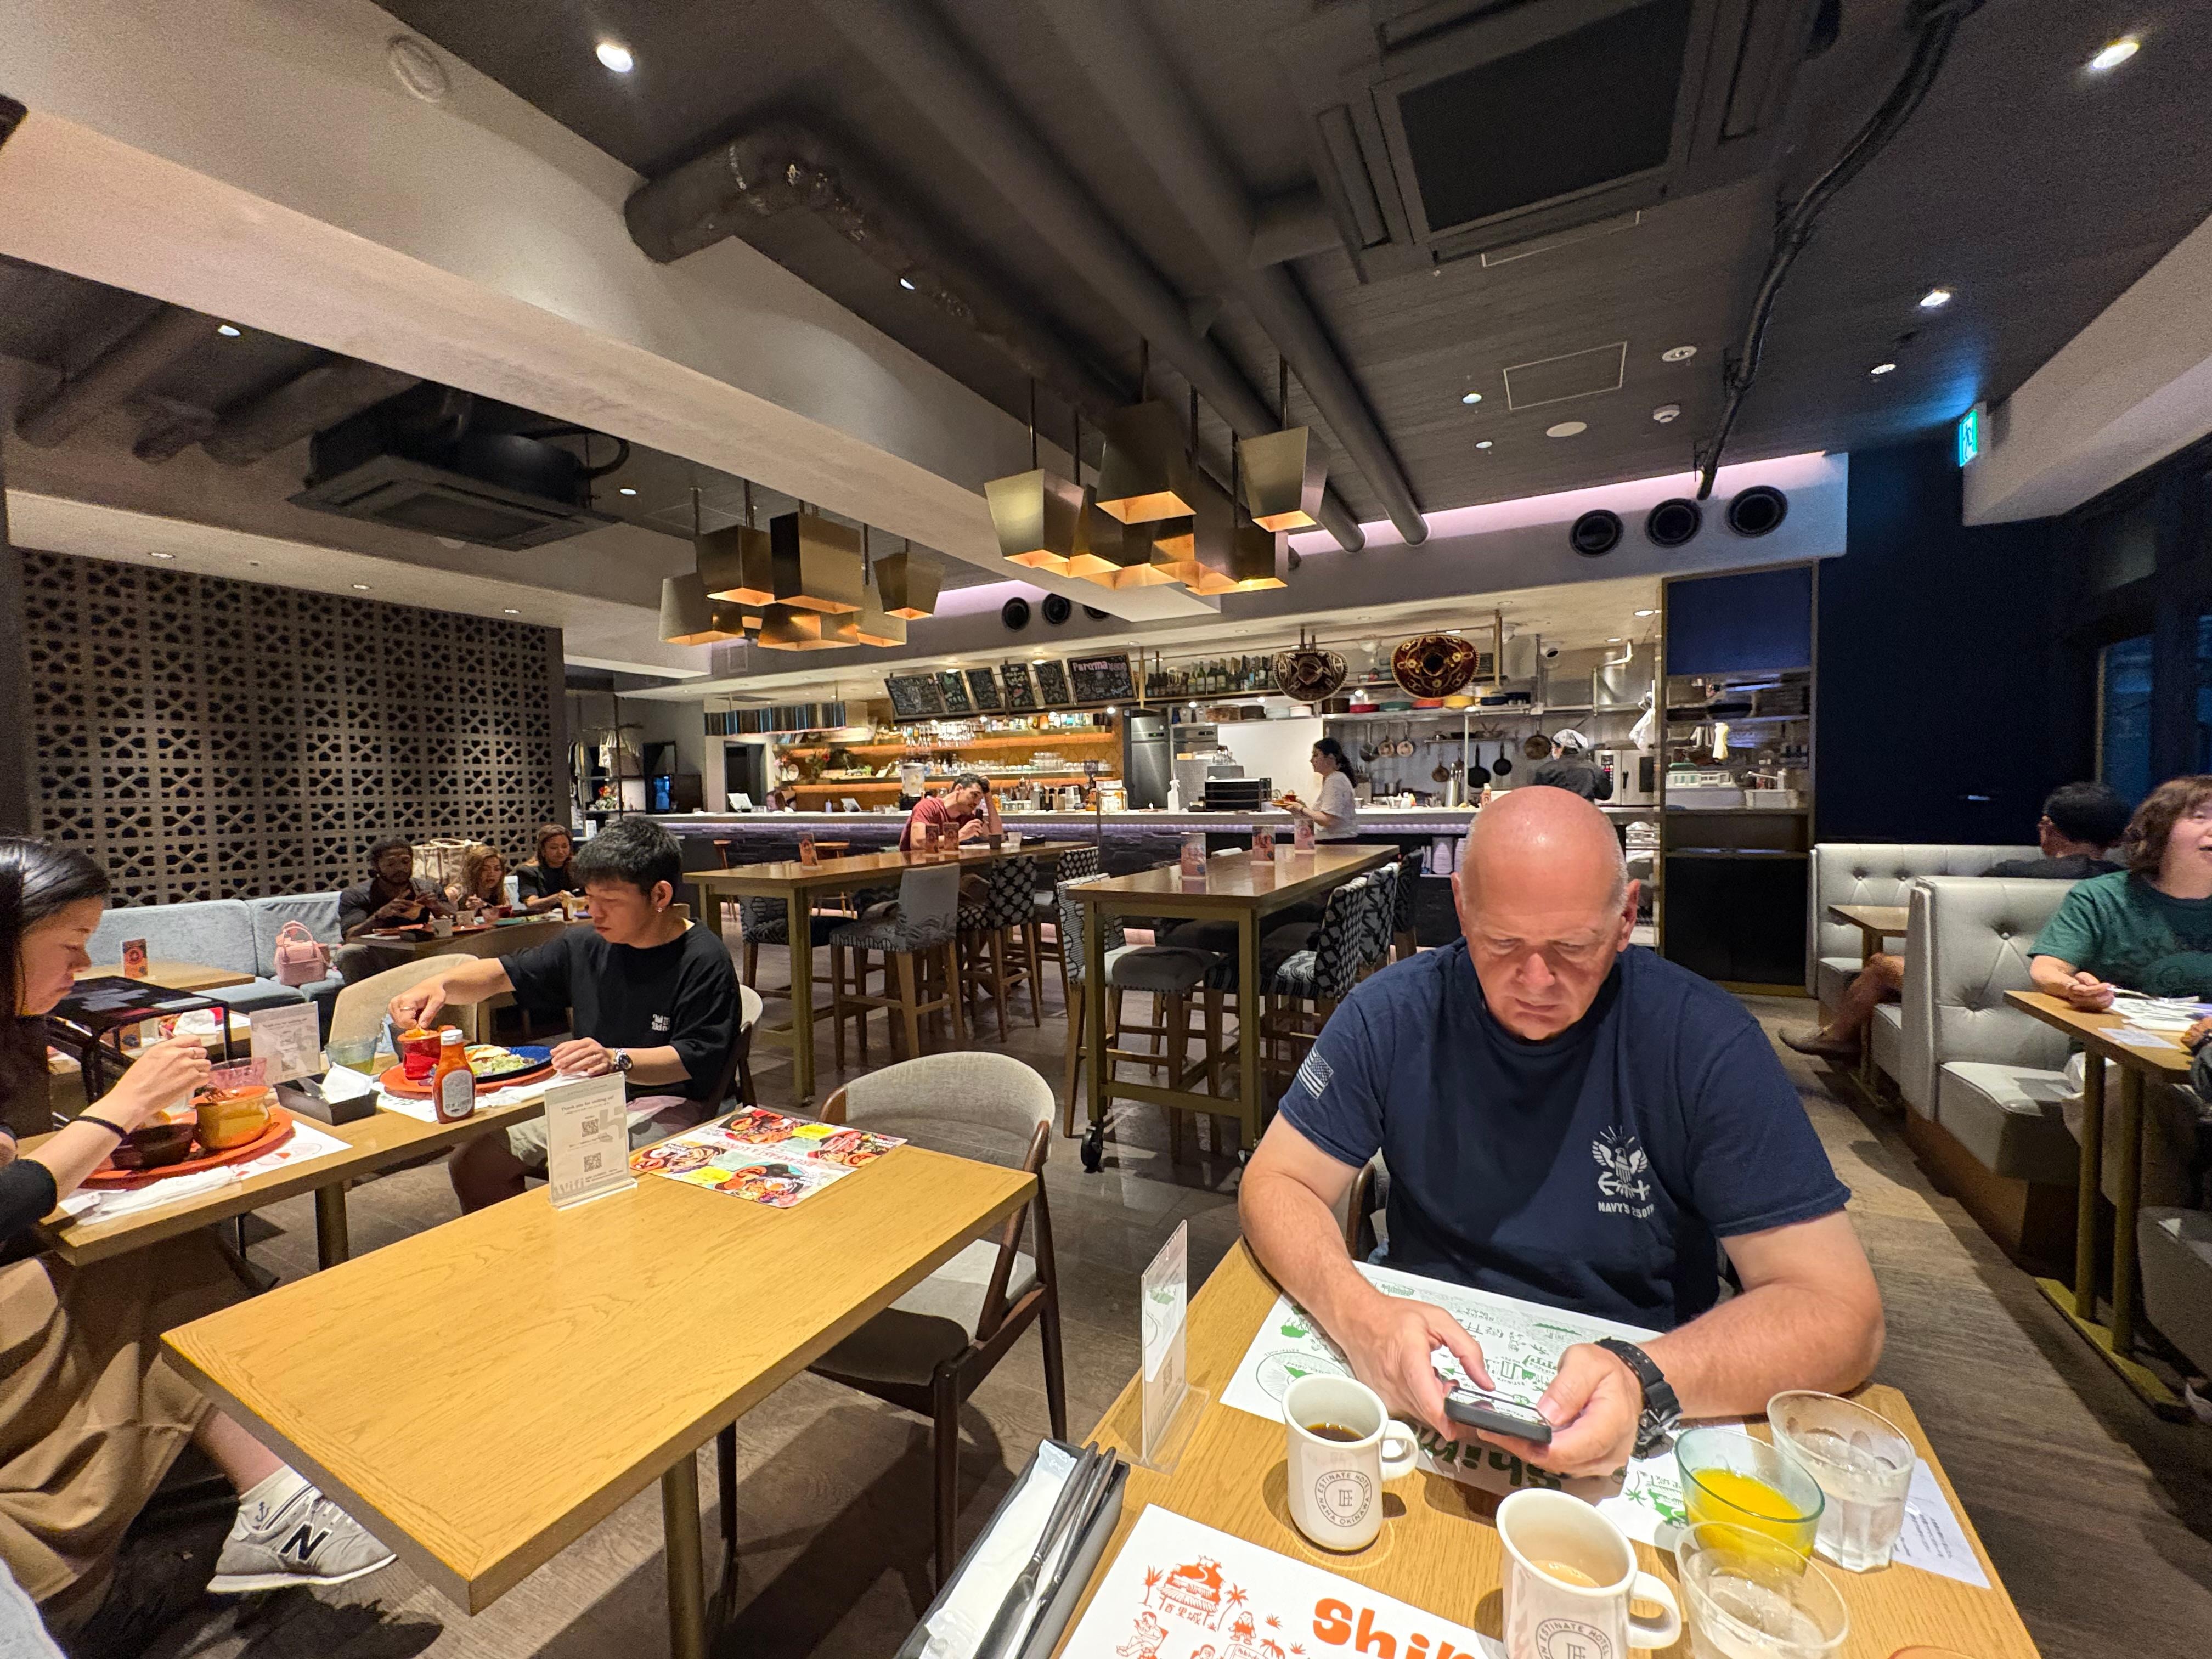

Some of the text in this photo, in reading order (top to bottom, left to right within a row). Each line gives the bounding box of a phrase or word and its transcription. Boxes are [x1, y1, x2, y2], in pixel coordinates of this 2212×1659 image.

[755, 1150, 817, 1167] BREAKFAST
[1597, 1201, 1655, 1219] NAVY'S 250TH
[1317, 1472, 1370, 1494] ESTINATE HOTEL
[1318, 1497, 1370, 1525] NAHA OKINAWA
[277, 1521, 334, 1562] N
[1539, 1622, 1610, 1656] ESTINATE HOTEL
